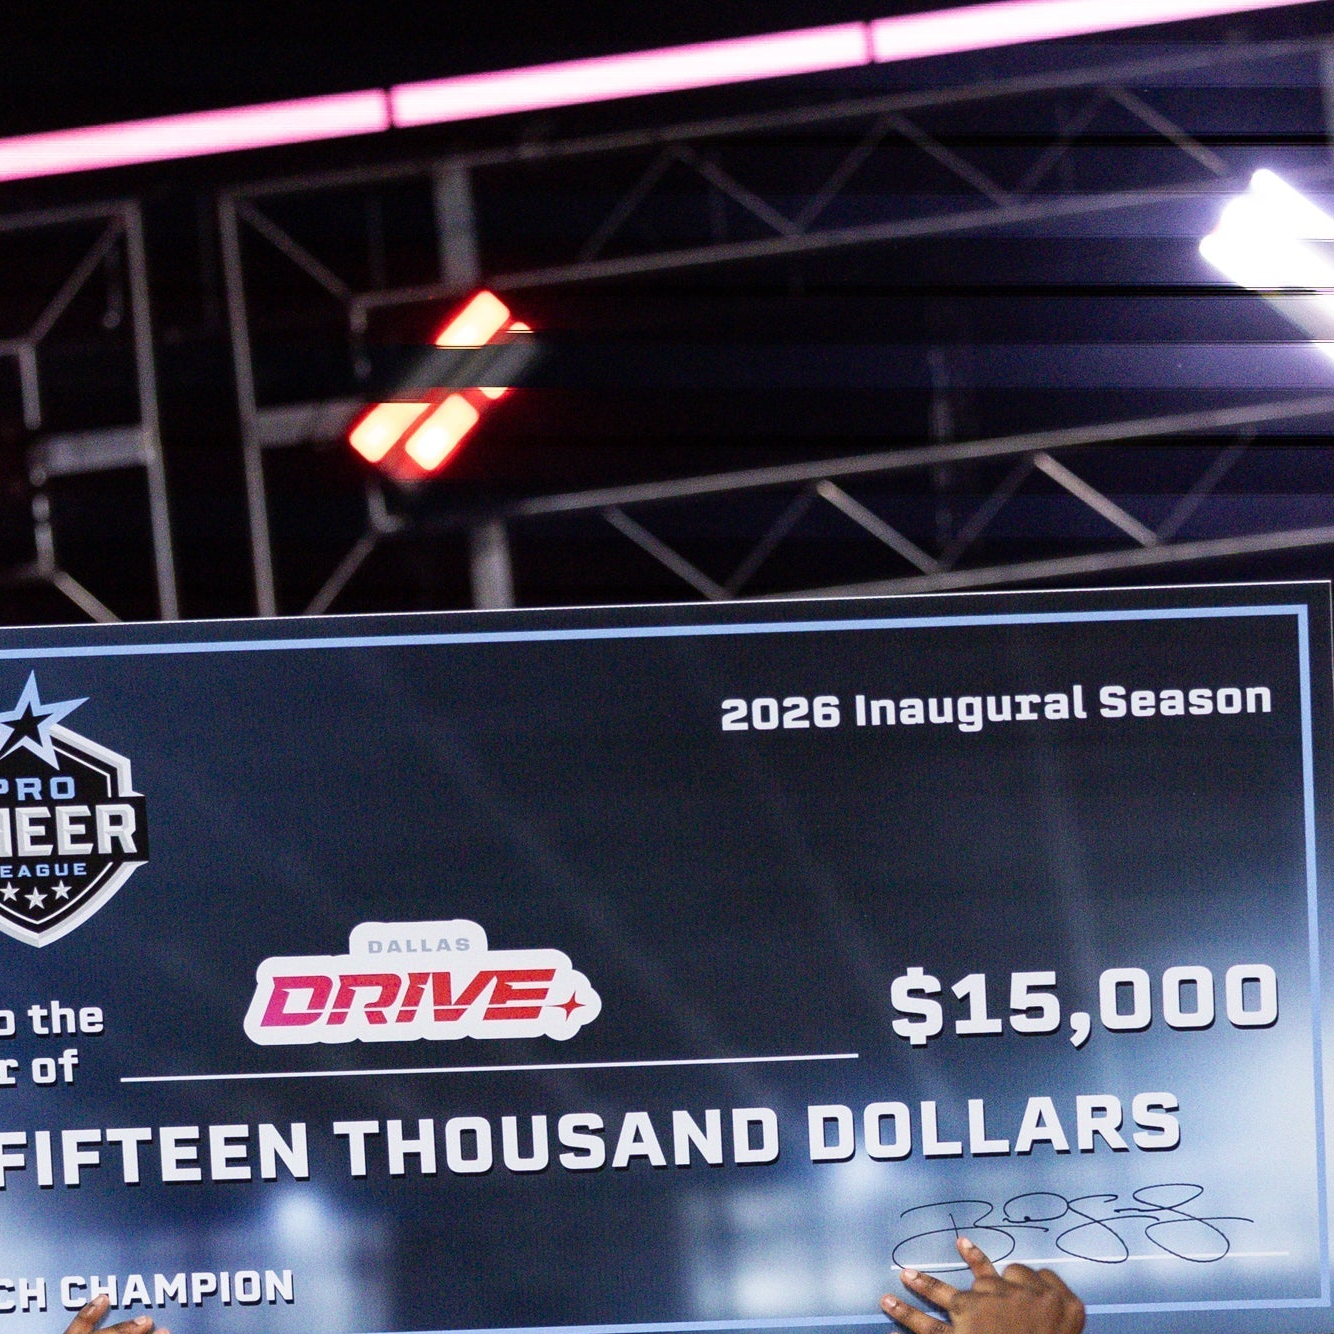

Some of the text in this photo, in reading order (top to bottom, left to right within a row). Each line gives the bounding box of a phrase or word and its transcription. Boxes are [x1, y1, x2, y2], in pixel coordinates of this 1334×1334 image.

[722, 685, 1273, 733] 2026 Inaugural Season
[368, 938, 472, 955] DALLAS
[28, 1001, 105, 1036] the
[261, 968, 559, 1028] DRIVE
[891, 965, 1280, 1048] $15,000
[31, 1049, 81, 1085] of
[333, 1107, 780, 1178] THOUSAND
[808, 1092, 1181, 1161] DOLLARS
[60, 1269, 295, 1310] CHAMPION
